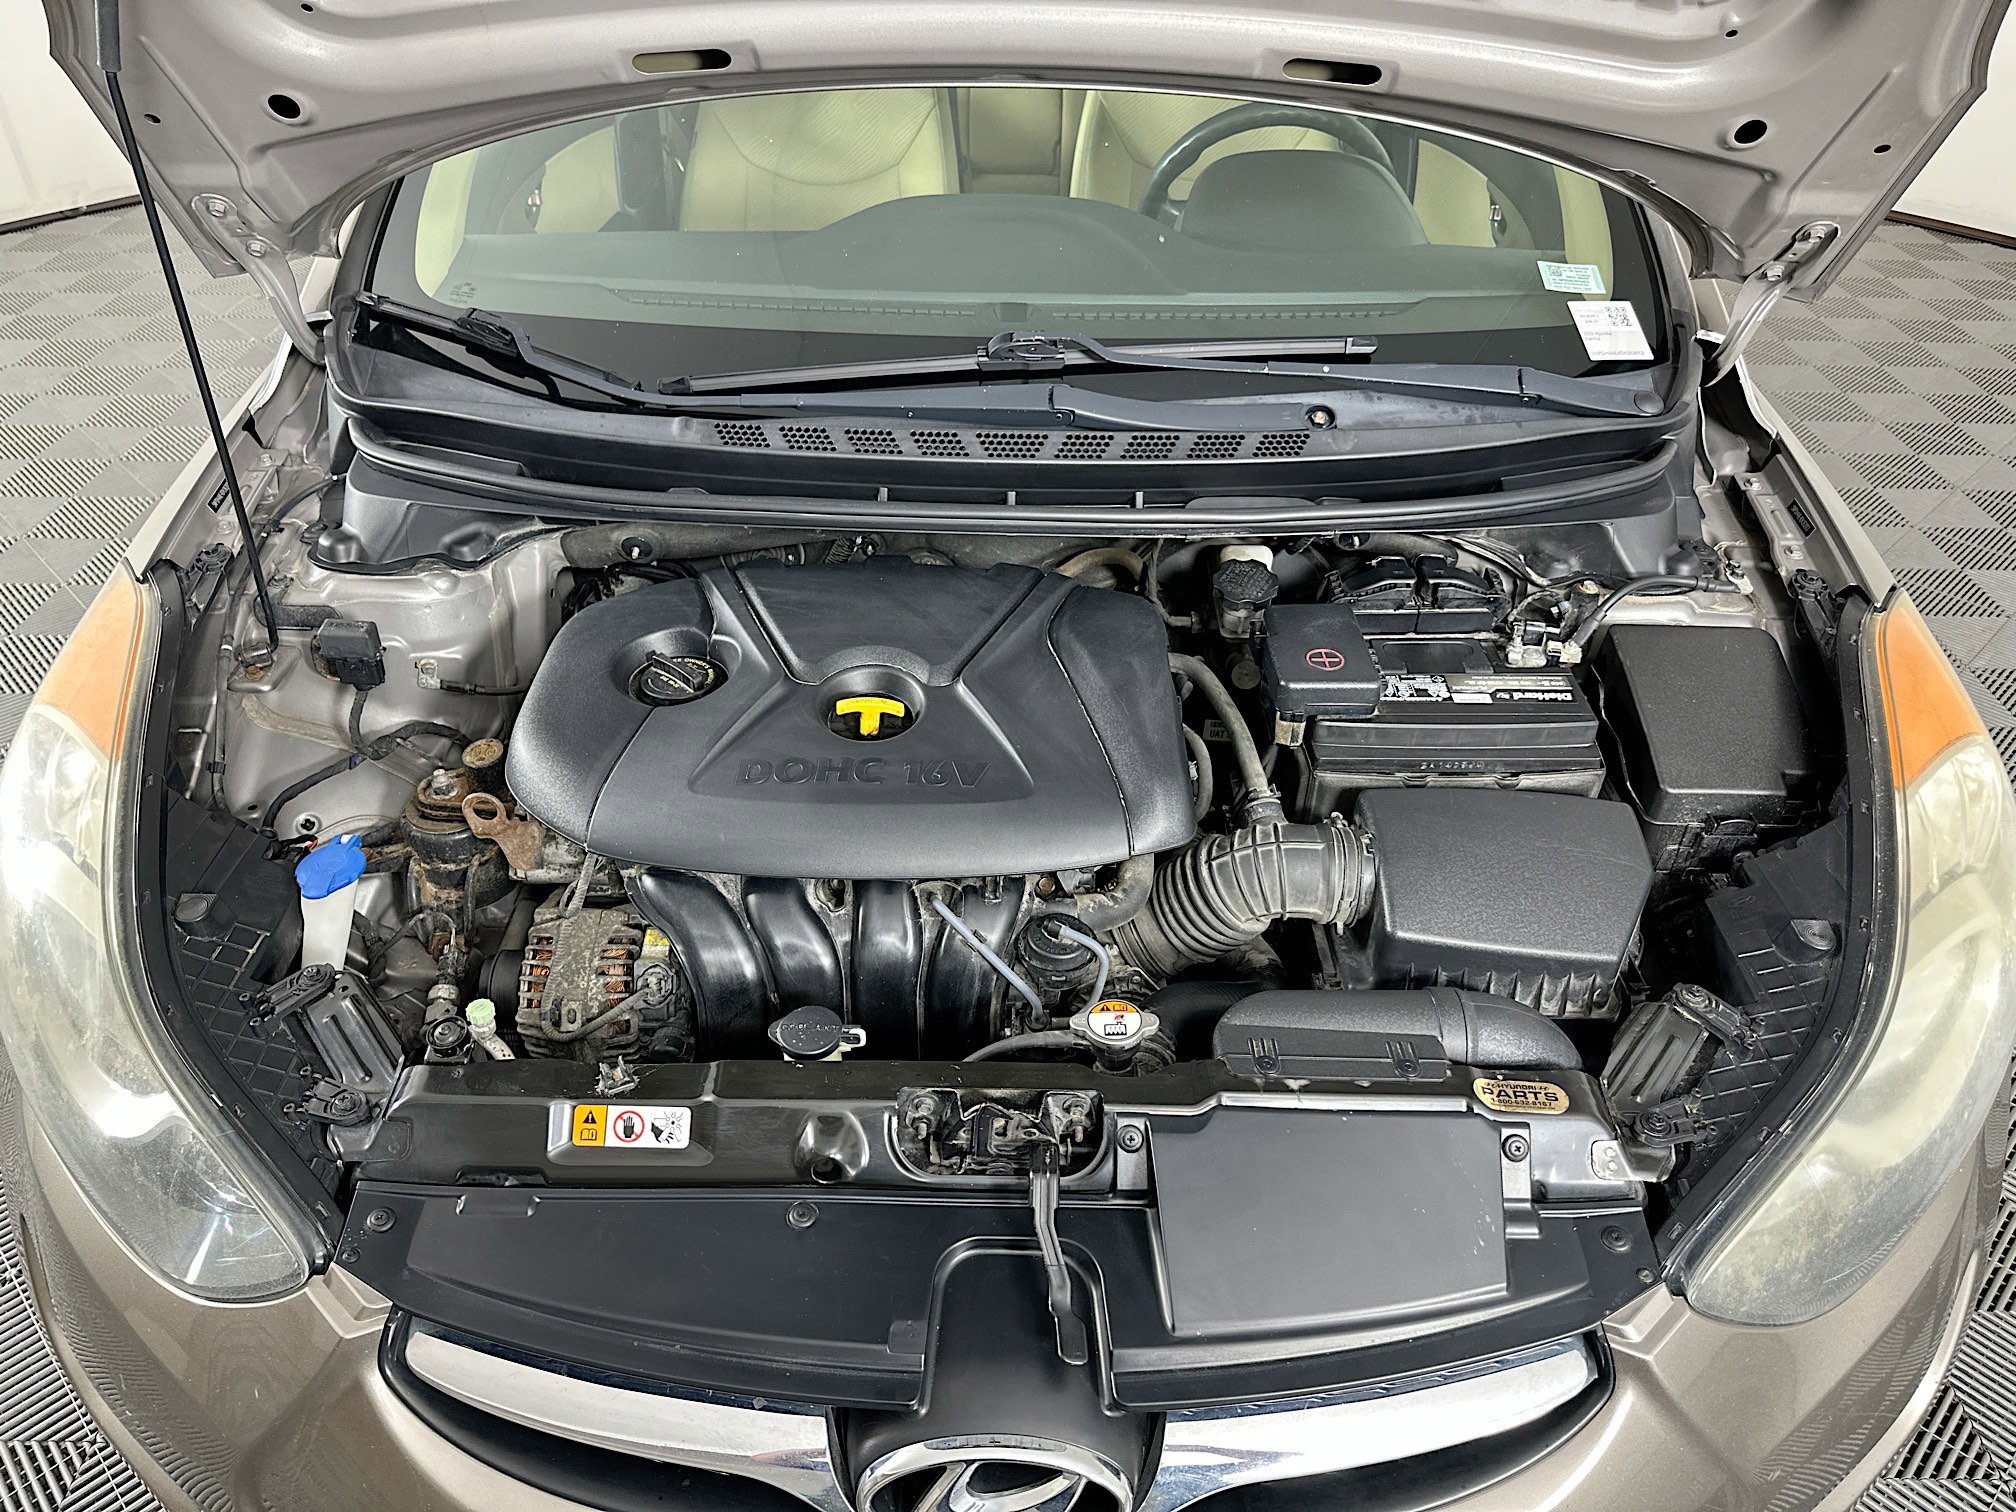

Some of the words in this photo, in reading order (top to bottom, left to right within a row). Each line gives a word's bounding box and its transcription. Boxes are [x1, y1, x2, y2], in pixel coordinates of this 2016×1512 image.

[1512, 692, 1573, 702] DieHard
[736, 757, 886, 785] DOHC
[903, 760, 991, 788] 16V
[1497, 1083, 1537, 1091] HYUNDAI
[1481, 1086, 1559, 1102] PARTS
